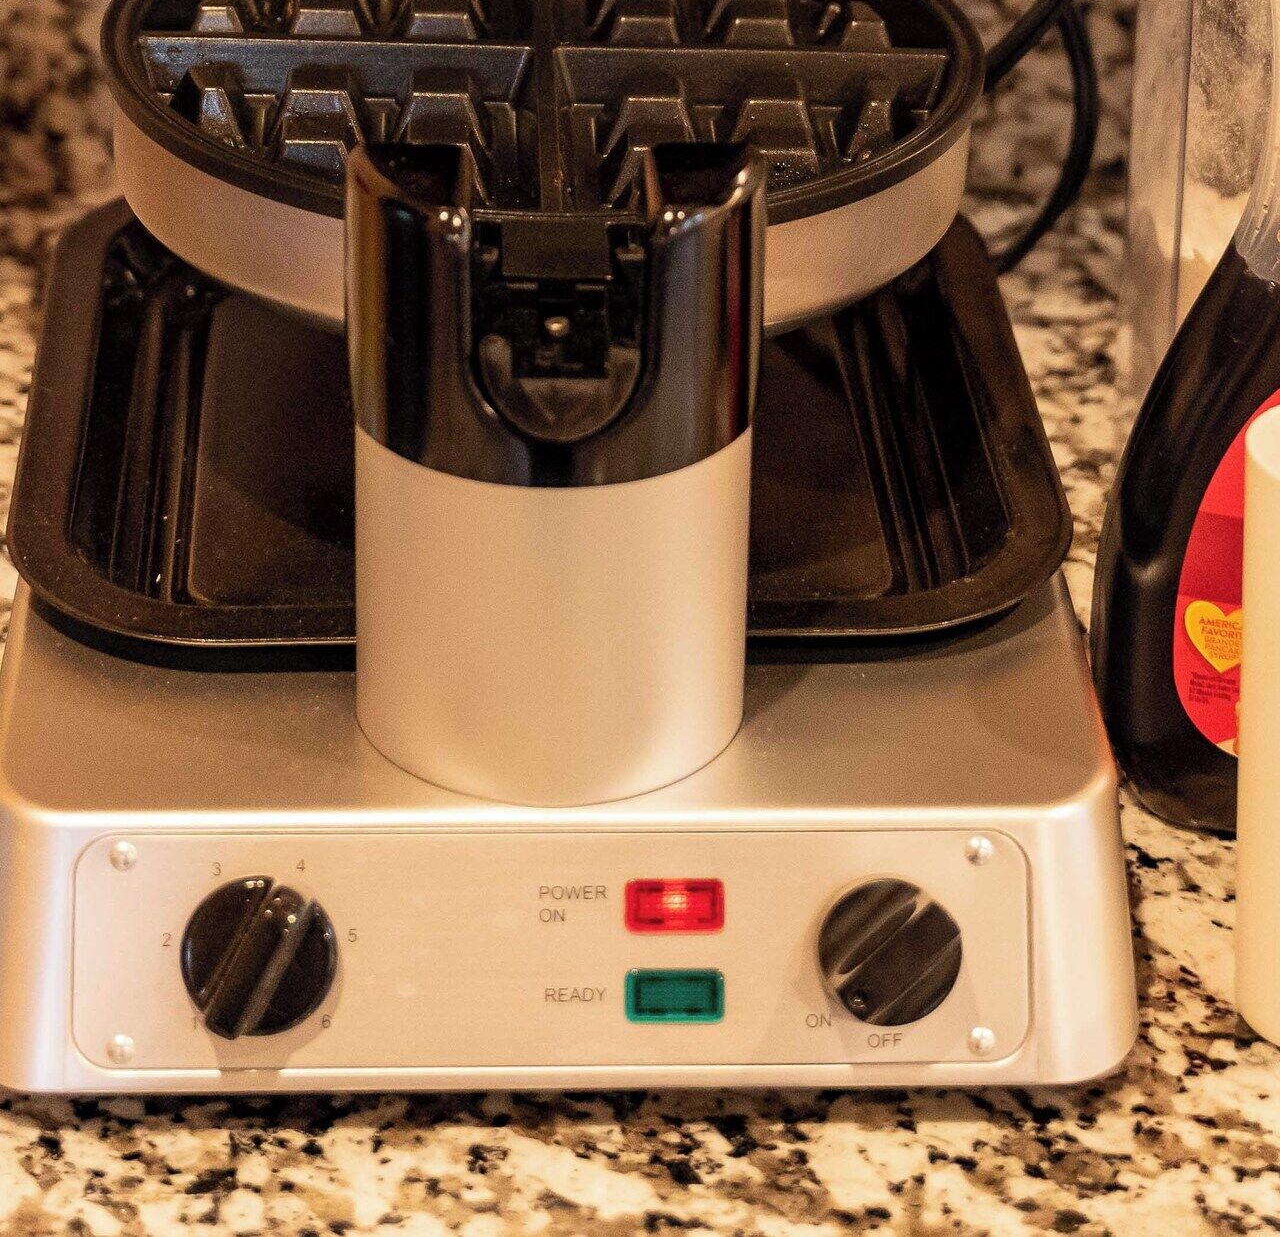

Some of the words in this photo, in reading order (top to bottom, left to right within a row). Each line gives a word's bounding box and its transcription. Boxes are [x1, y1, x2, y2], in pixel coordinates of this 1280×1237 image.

[212, 861, 222, 876] 3
[296, 859, 306, 872] 4
[539, 885, 607, 900] POWER
[539, 908, 565, 922] ON
[162, 932, 172, 947] 2
[348, 928, 357, 943] 5
[544, 987, 606, 1002] READY
[322, 1014, 331, 1029] 6
[805, 1013, 832, 1028] ON
[867, 1033, 902, 1048] OFF
